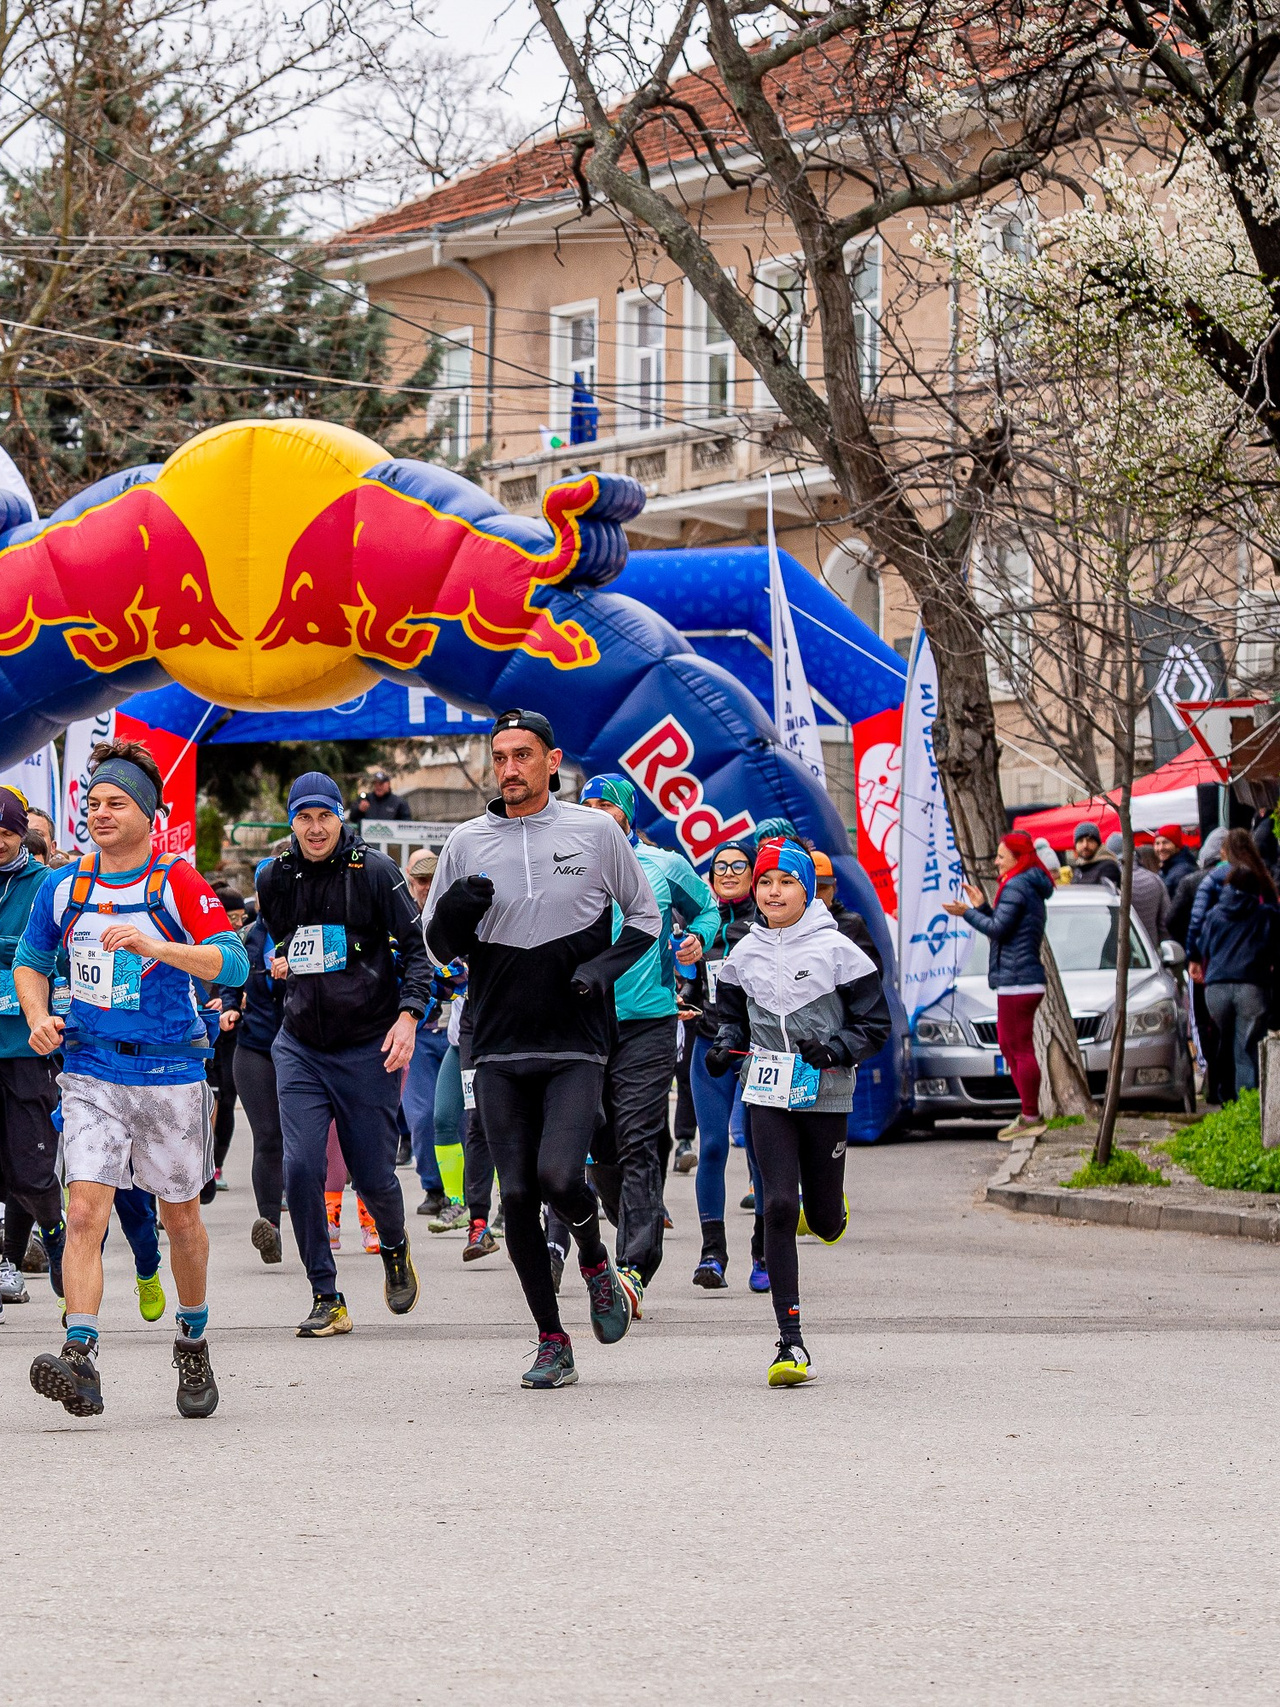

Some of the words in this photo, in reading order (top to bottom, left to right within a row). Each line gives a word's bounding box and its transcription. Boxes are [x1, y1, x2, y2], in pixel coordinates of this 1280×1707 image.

[623, 718, 753, 862] Red
[552, 865, 588, 876] NIKE
[293, 940, 315, 956] 227
[77, 962, 101, 984] 160
[758, 1067, 779, 1085] 121
